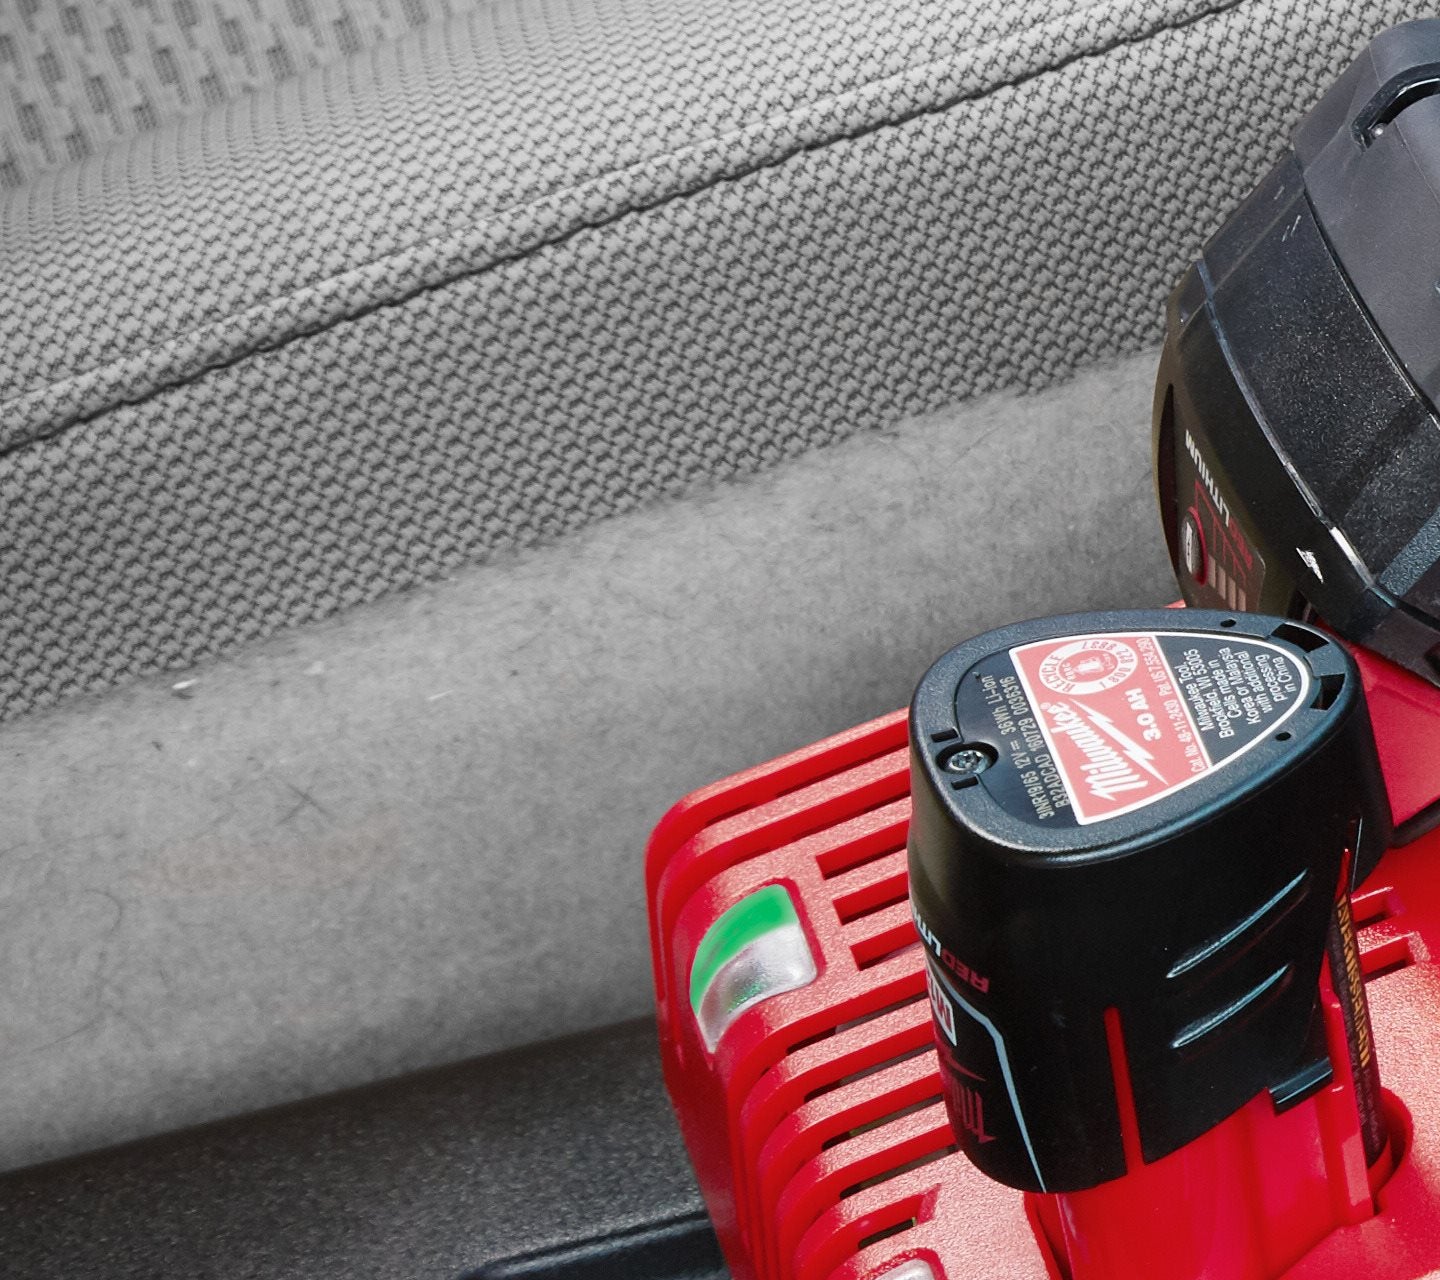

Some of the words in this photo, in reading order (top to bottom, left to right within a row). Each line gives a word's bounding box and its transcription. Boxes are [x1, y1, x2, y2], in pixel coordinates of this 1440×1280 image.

[1041, 654, 1075, 692] RECYCLE
[1184, 649, 1207, 675] 53005
[1208, 660, 1220, 668] in
[1219, 647, 1244, 685] Malaysia
[1234, 651, 1264, 692] additional
[1272, 657, 1292, 682] China
[1196, 676, 1212, 689] WI
[1212, 670, 1231, 694] made
[1236, 687, 1249, 695] or
[1255, 655, 1287, 702] processing
[1285, 683, 1295, 692] in
[1125, 689, 1148, 709] AH
[1186, 683, 1214, 730] Milwaukee
[1223, 695, 1242, 718] Cells
[1241, 696, 1260, 724] Korea
[1254, 693, 1272, 713] with
[1137, 714, 1160, 740] 3.0
[1045, 702, 1148, 800] Milwaukee
